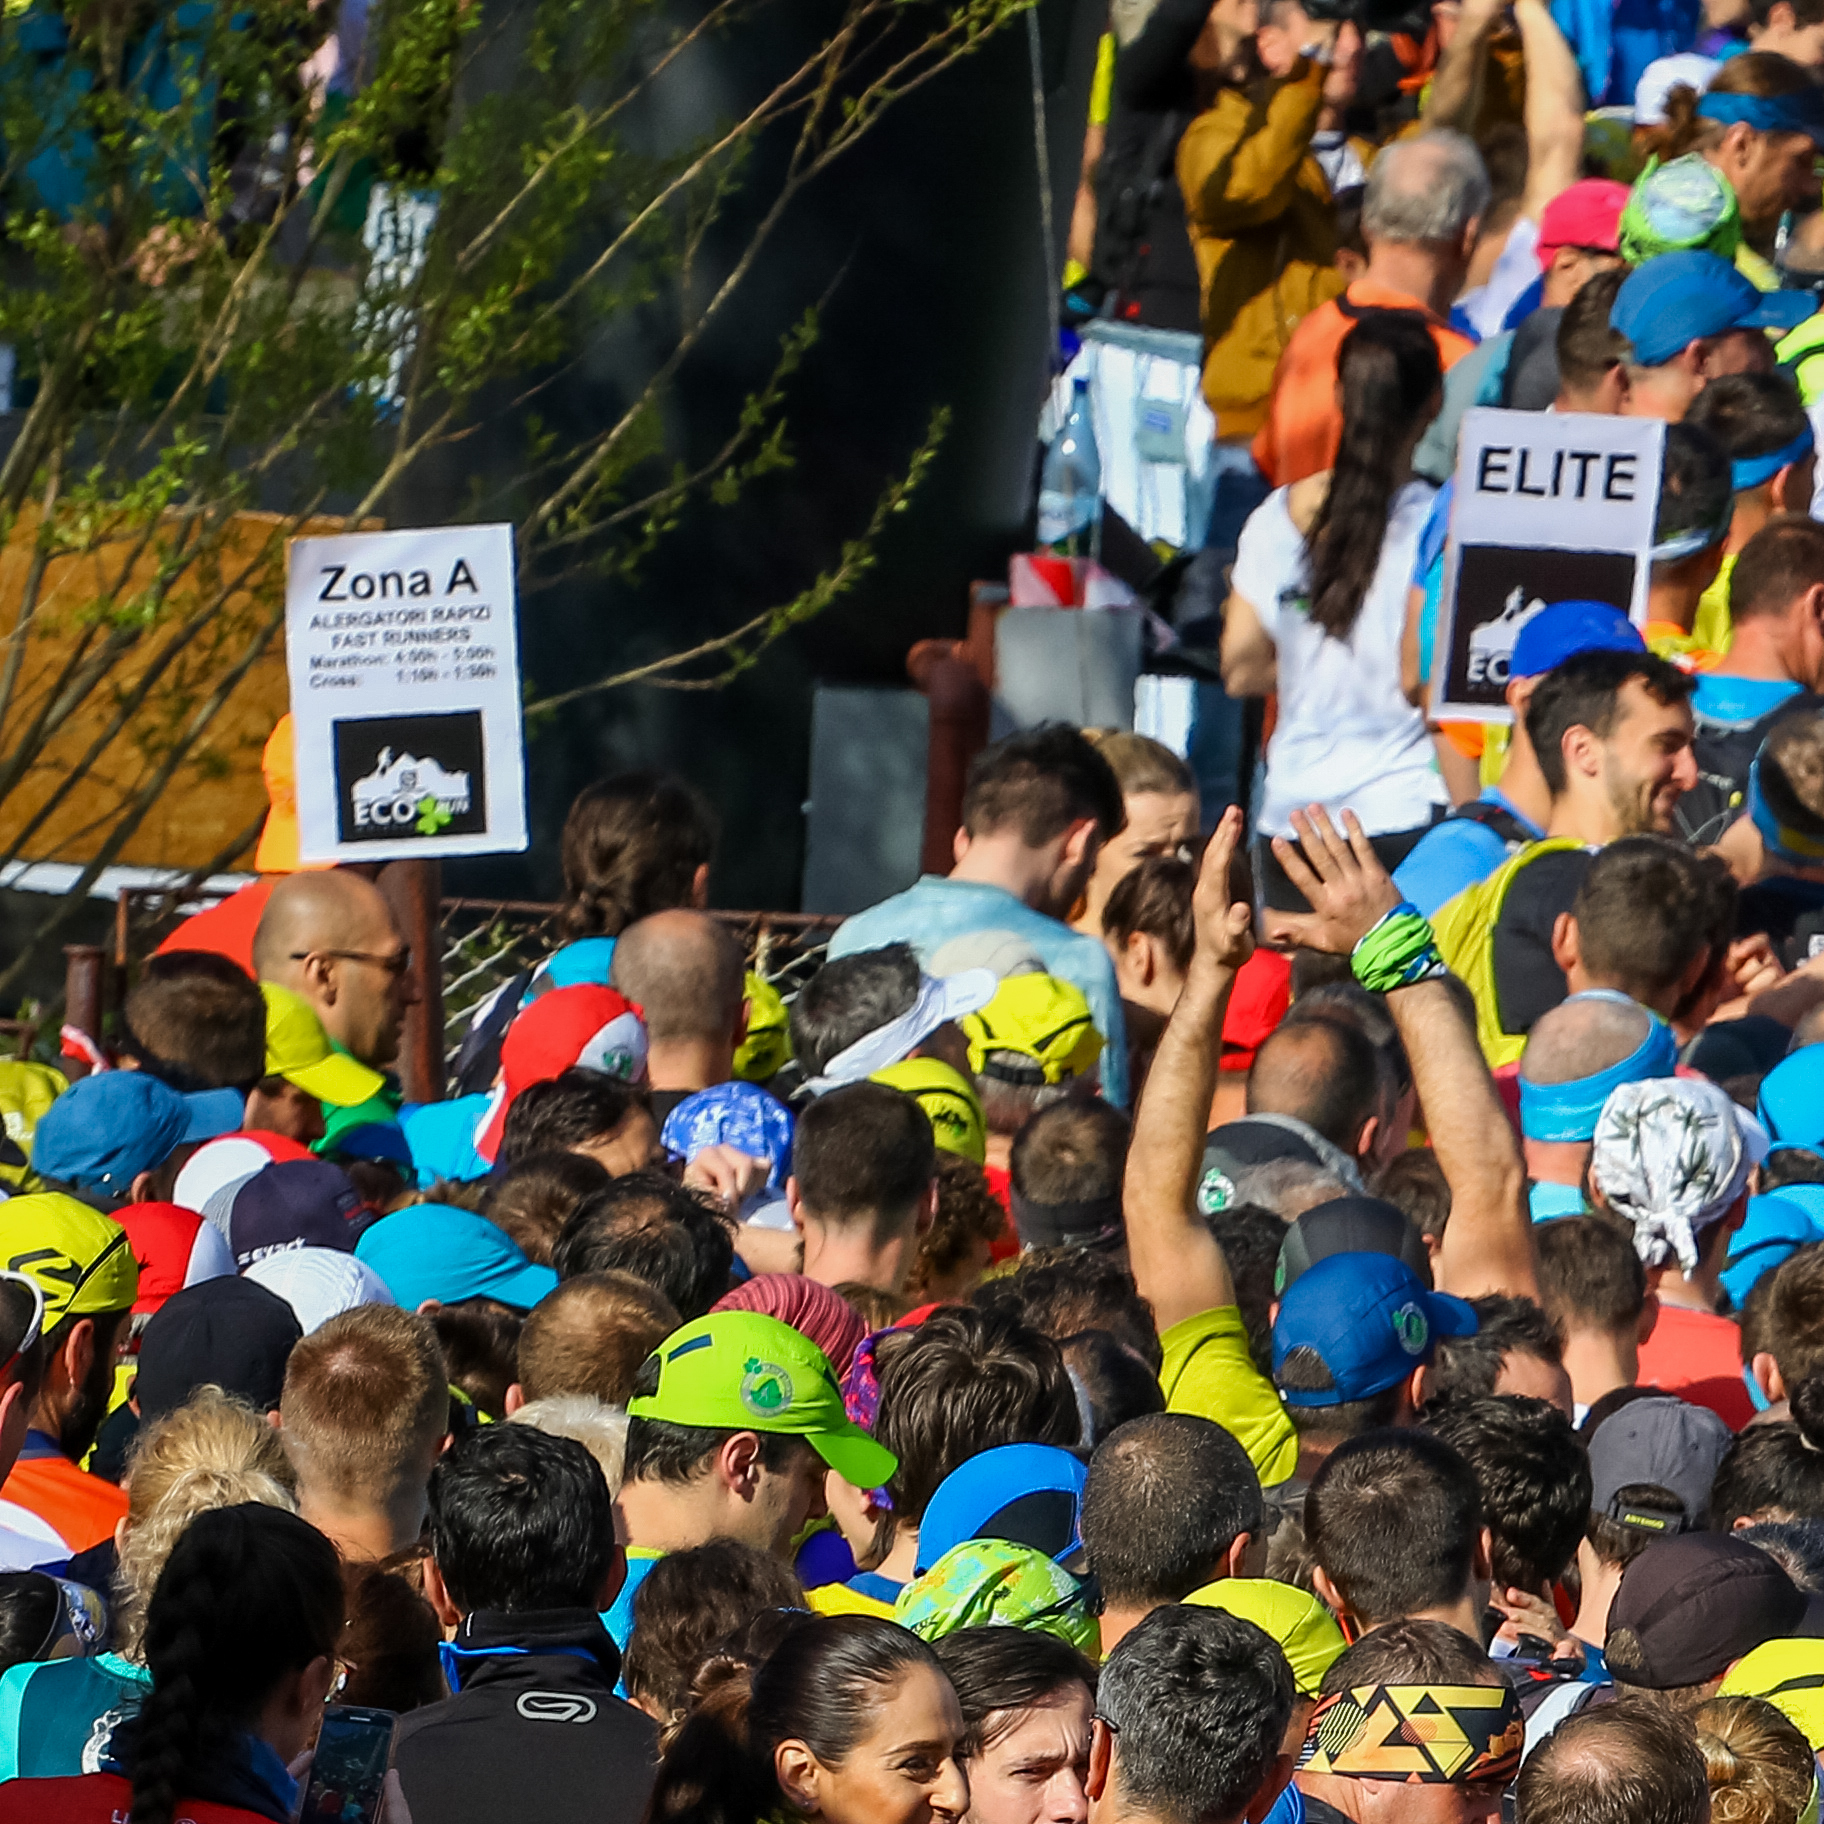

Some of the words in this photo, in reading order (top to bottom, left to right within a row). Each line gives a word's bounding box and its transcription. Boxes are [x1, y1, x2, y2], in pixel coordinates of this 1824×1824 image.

[1475, 445, 1638, 501] ELITE
[318, 563, 431, 601] Zona
[445, 558, 478, 594] A
[331, 632, 377, 649] FAST
[383, 626, 471, 646] RUNNERS
[1467, 652, 1511, 686] EC
[354, 797, 416, 826] ECO
